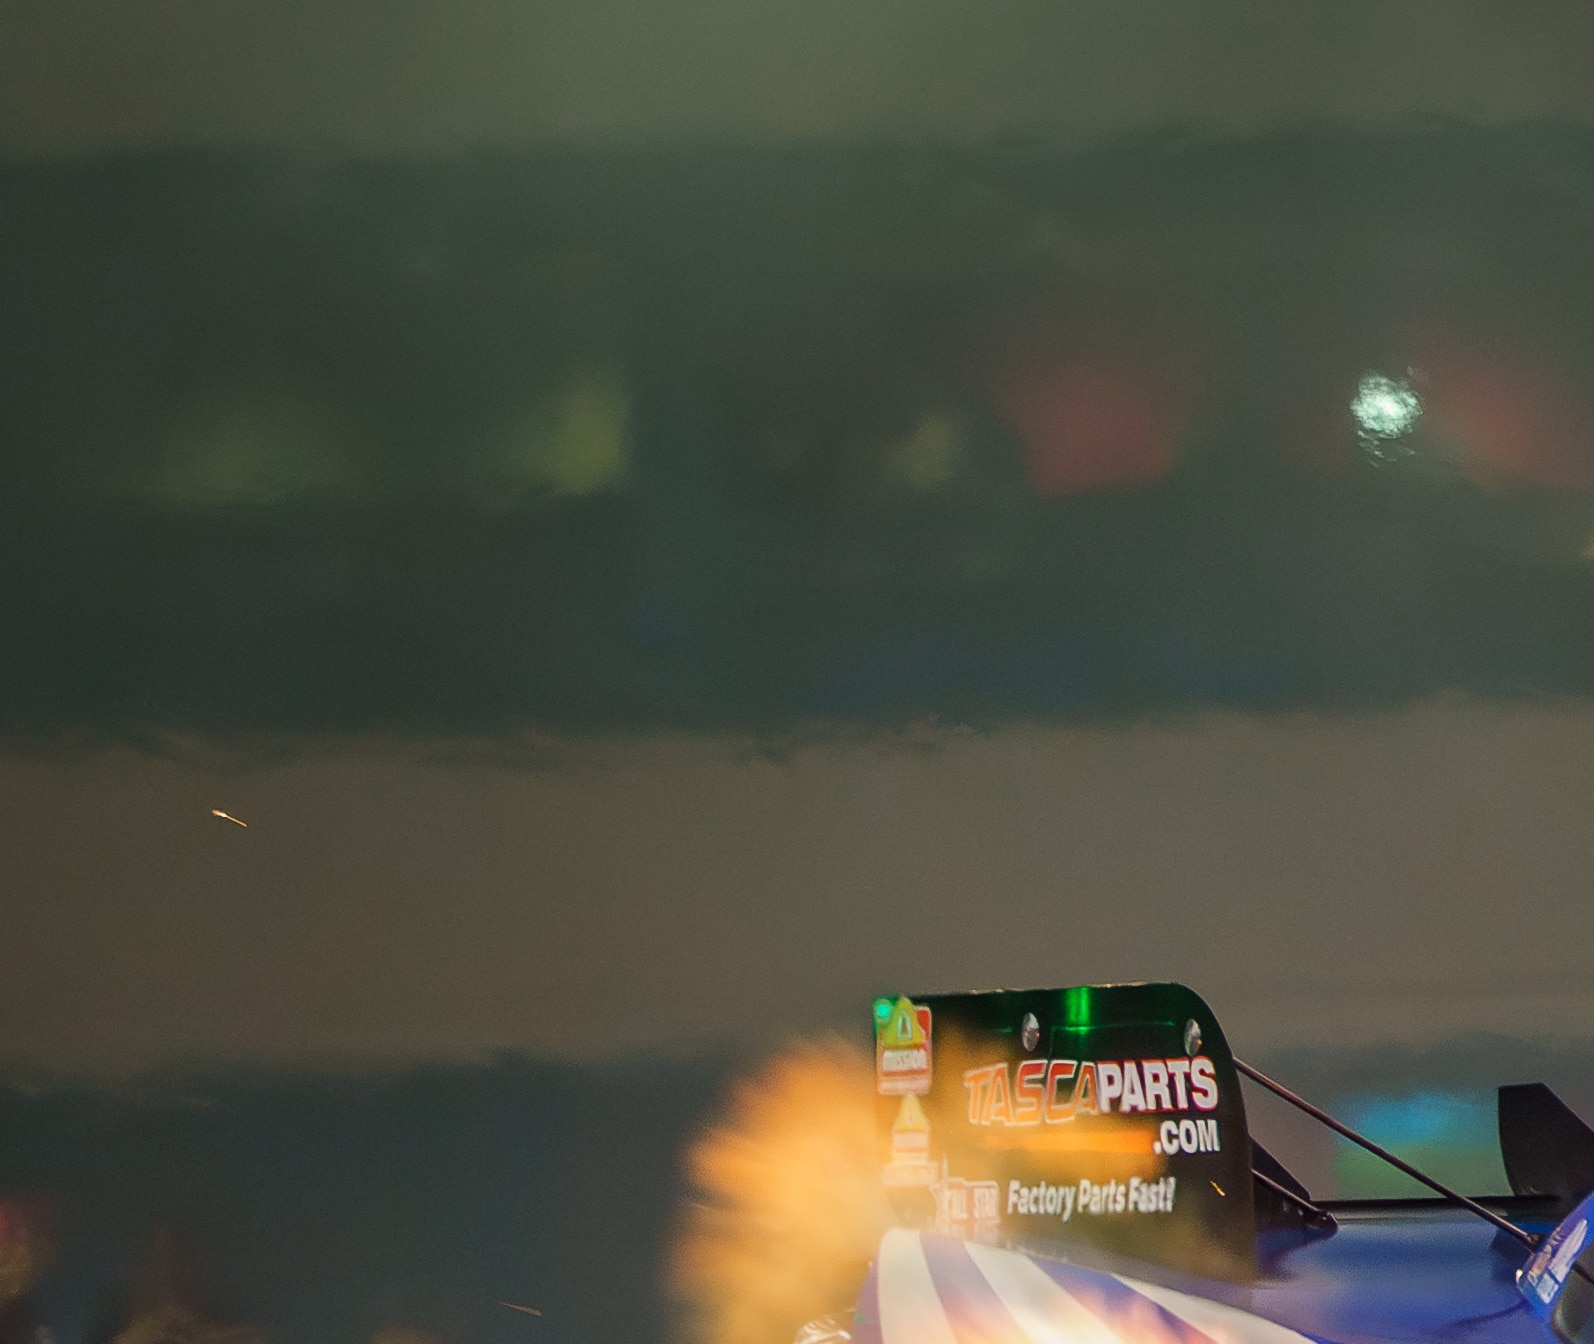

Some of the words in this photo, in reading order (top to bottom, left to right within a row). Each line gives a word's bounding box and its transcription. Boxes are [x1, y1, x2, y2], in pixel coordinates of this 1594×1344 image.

[963, 1056, 1218, 1126] TASCAPARTS
[1153, 1120, 1220, 1154] .COM
[1007, 1180, 1075, 1222] Factory
[1077, 1179, 1127, 1213] Parts
[1128, 1177, 1176, 1213] Fast!
